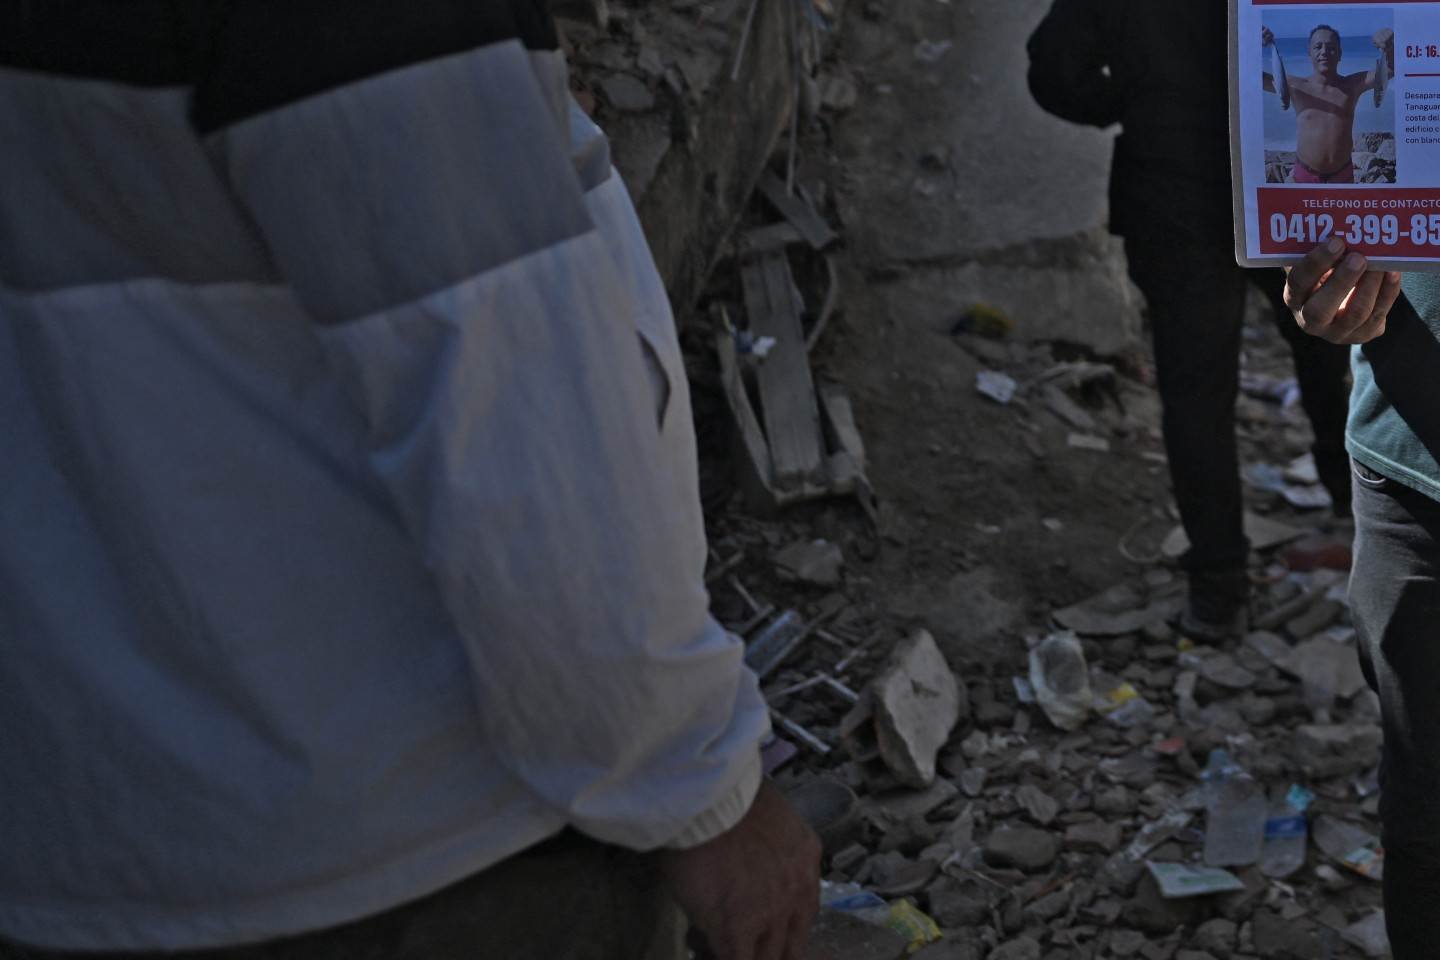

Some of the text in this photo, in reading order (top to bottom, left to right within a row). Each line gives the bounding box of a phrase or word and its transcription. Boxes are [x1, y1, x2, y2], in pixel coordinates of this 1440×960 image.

[1405, 114, 1426, 122] costa
[1405, 125, 1433, 133] edificio
[1302, 197, 1361, 209] TELÉFONO
[1363, 199, 1378, 209] DE
